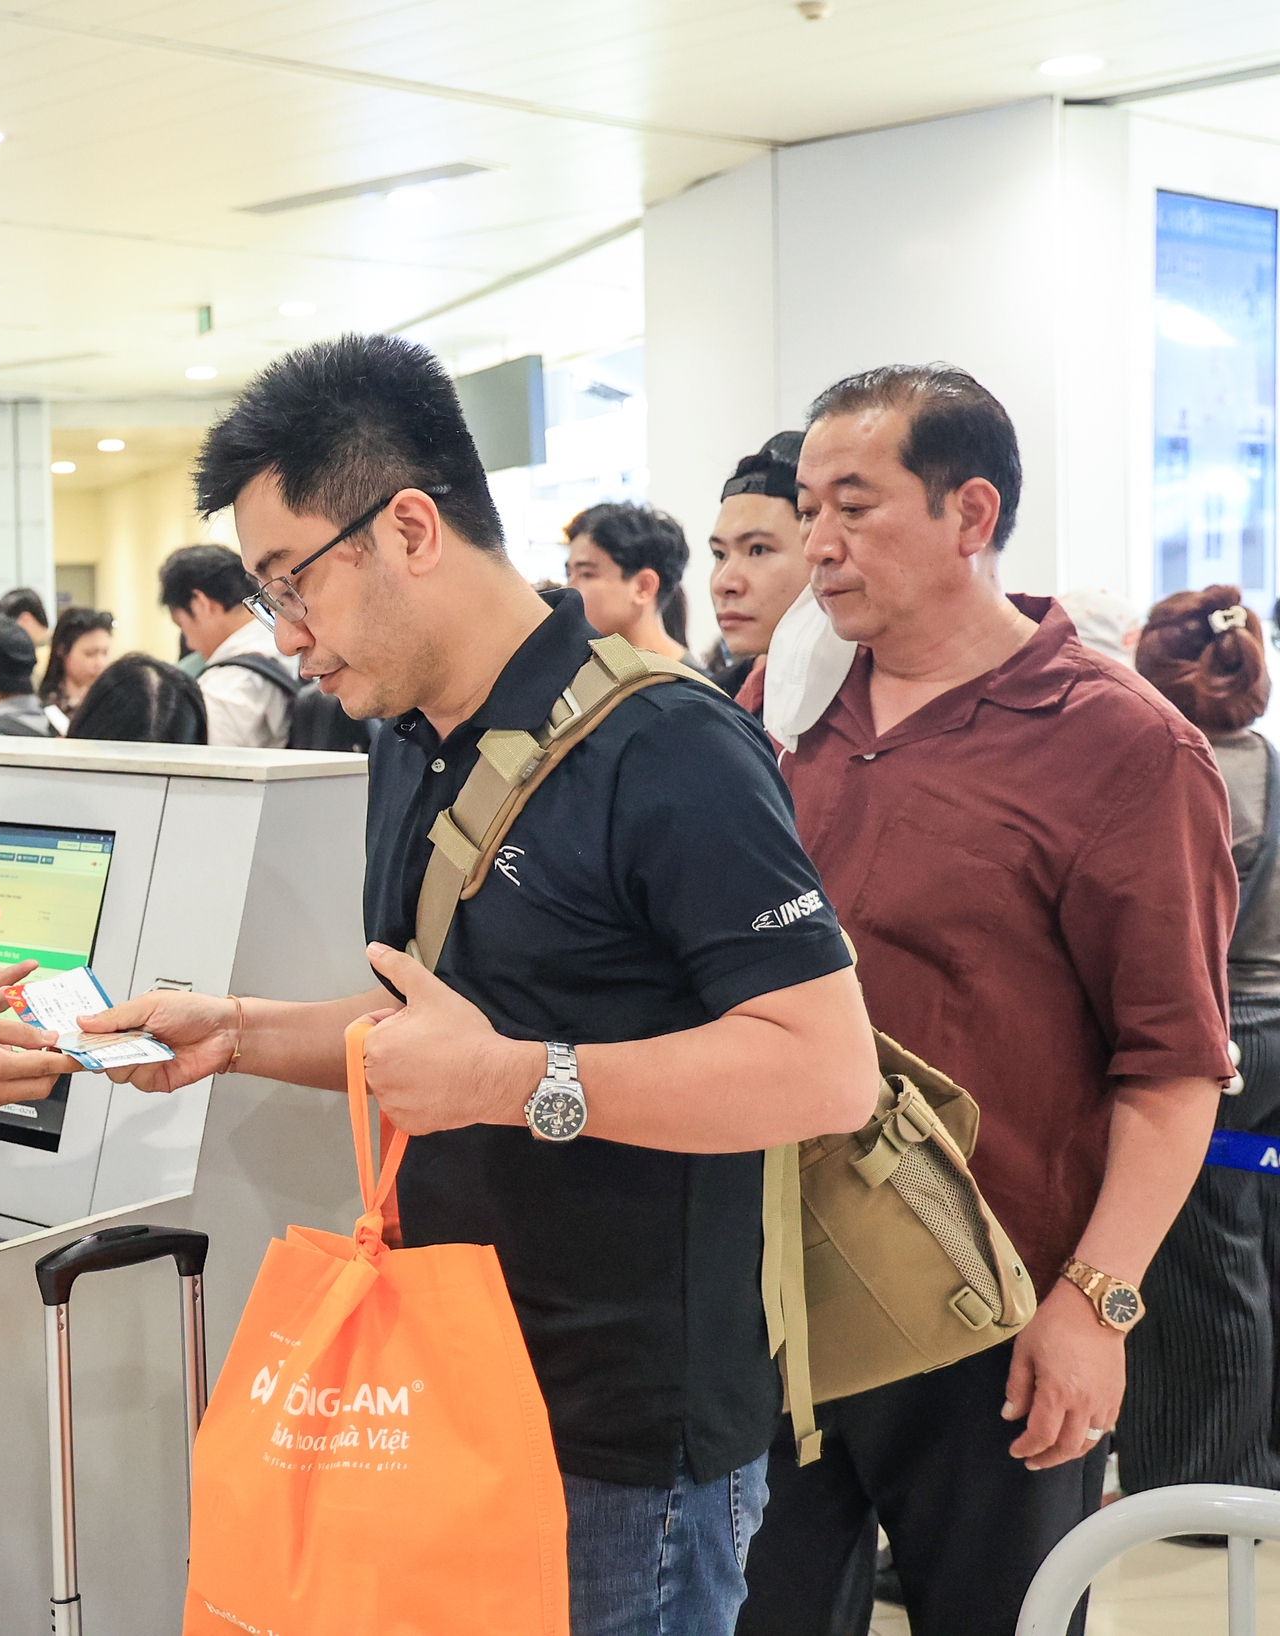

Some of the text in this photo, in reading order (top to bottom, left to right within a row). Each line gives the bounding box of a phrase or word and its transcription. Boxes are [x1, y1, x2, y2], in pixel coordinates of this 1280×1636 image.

[779, 889, 824, 926] INSEE
[1259, 1146, 1280, 1168] A
[367, 1427, 410, 1455] Việt
[300, 1462, 314, 1472] of
[376, 1460, 408, 1471] gifts
